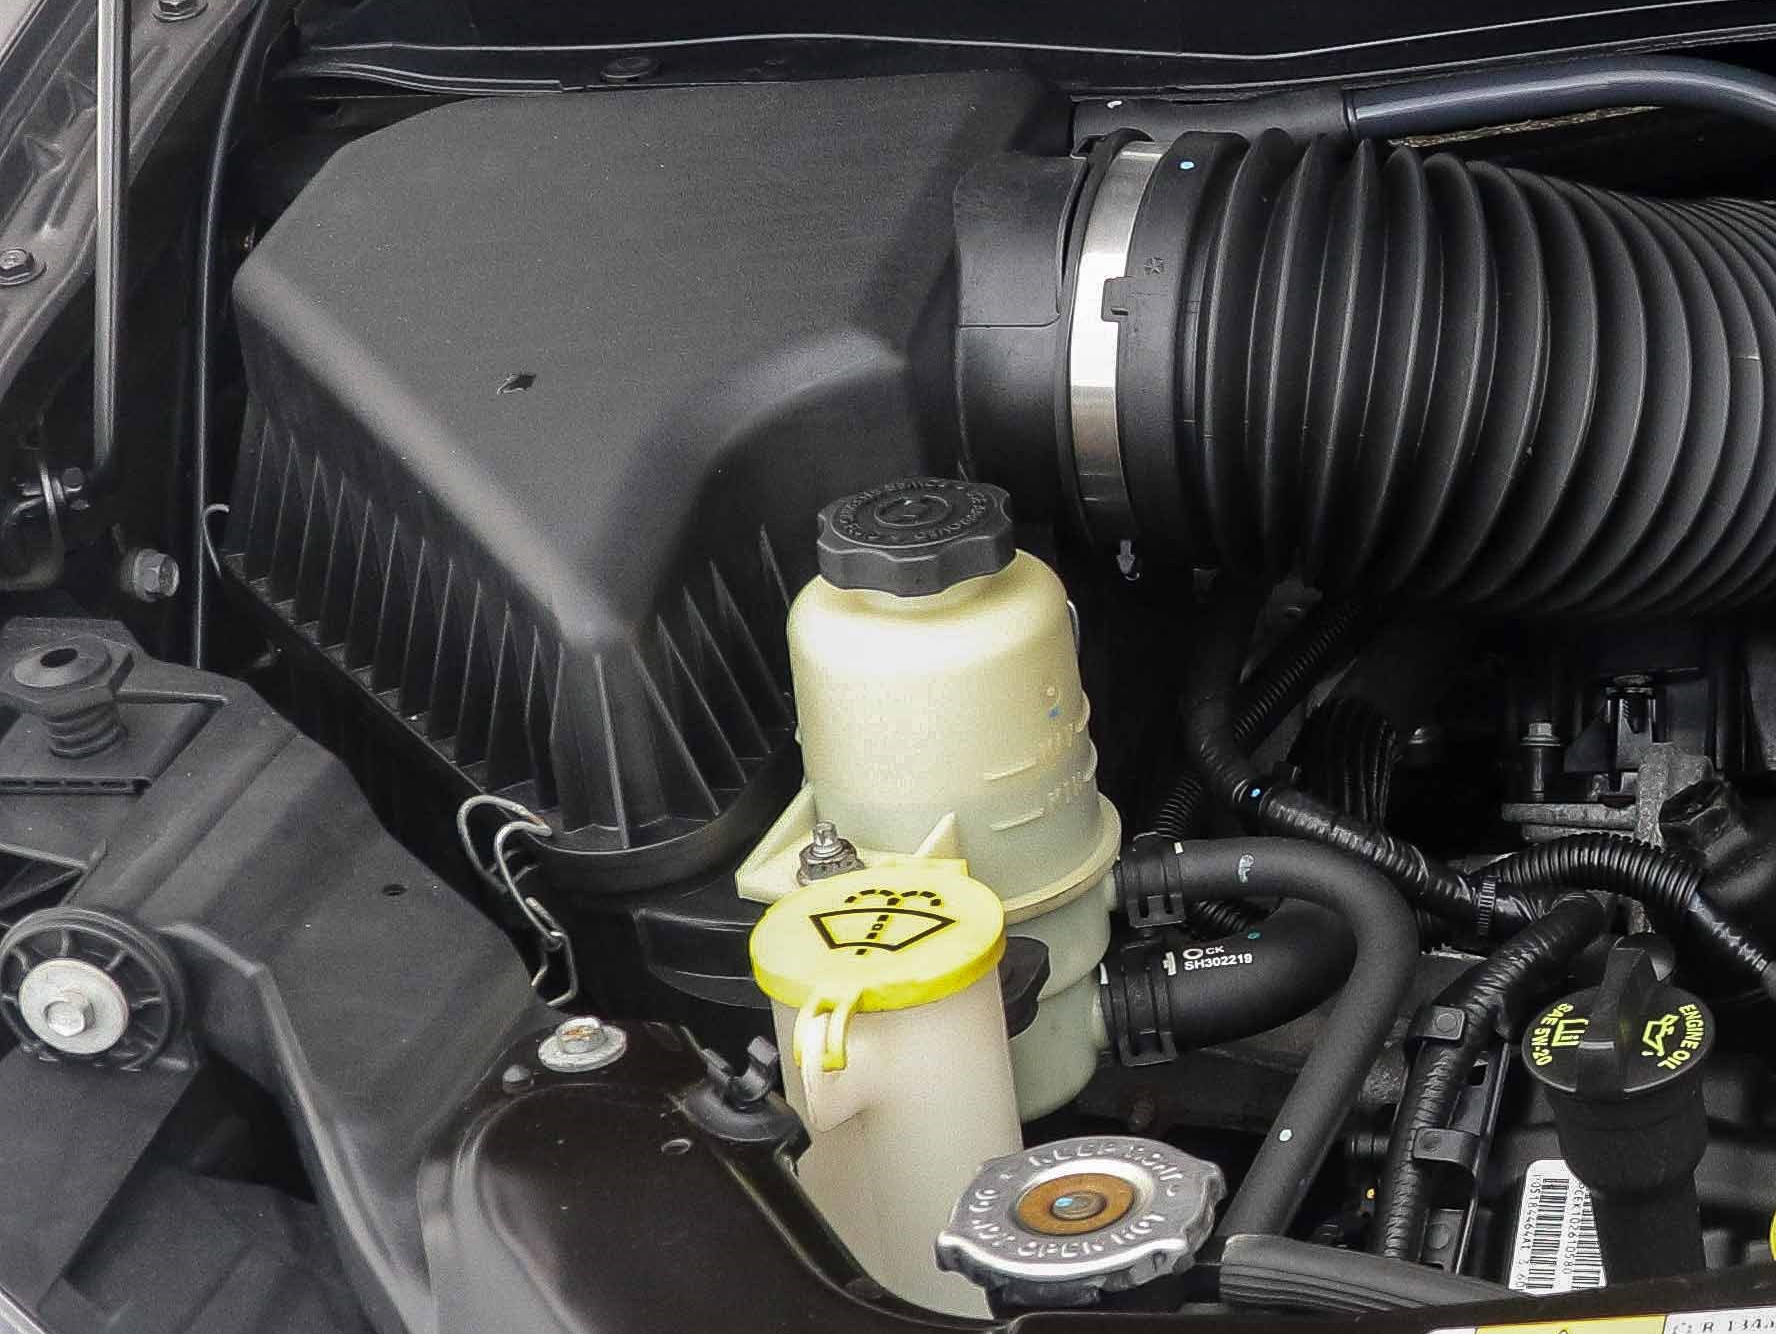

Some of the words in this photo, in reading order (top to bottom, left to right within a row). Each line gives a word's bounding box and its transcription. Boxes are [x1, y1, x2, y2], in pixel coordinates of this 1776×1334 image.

[1184, 953, 1252, 971] SH302219
[1541, 1003, 1574, 1026] SAE
[1679, 1004, 1704, 1050] ENGINE
[1531, 1027, 1553, 1067] 5W-20
[1657, 1050, 1690, 1070] OIL
